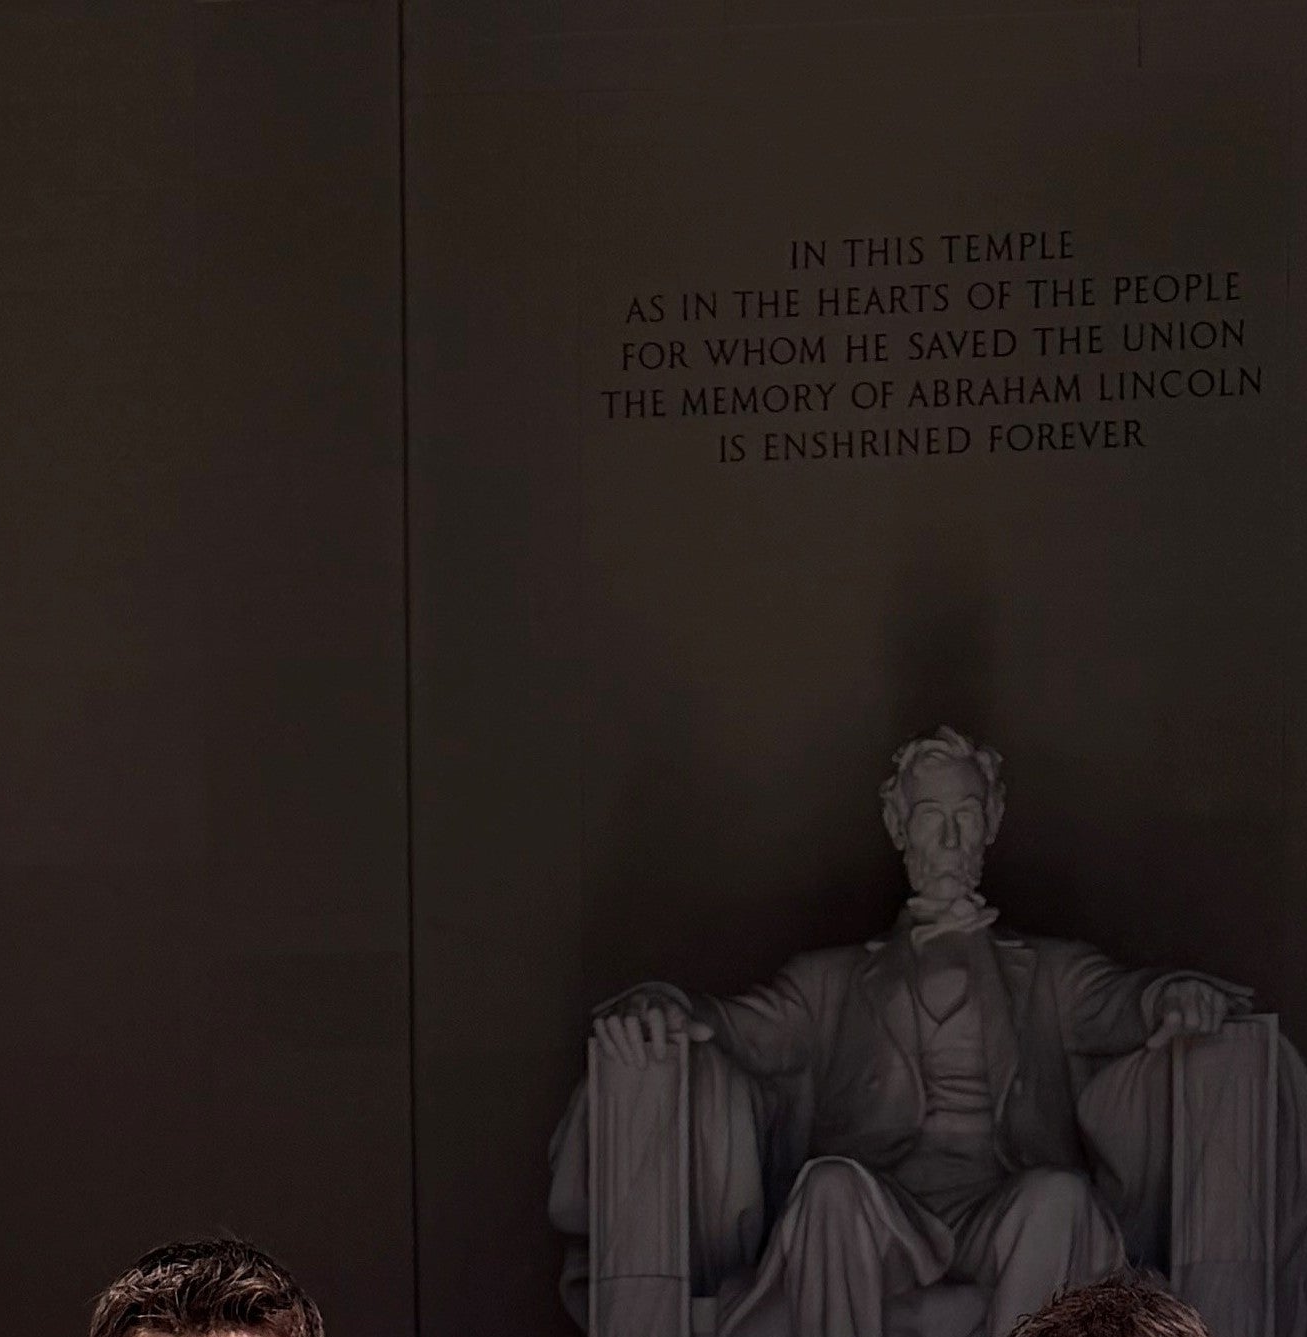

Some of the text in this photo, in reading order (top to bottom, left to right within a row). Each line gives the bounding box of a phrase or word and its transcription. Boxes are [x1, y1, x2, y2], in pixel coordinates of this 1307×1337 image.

[791, 230, 1074, 269] IN THIS TEMPLE
[625, 272, 1241, 323] AS IN THE HEARTS OF THE PEOPLE
[623, 319, 1245, 371] FOR WHOM HE SAVED THE UNION
[601, 367, 1263, 419] THE MEMORY OF ABRAHAM LINCOLN
[719, 419, 1148, 463] IS ENSHRINED FOREVER
